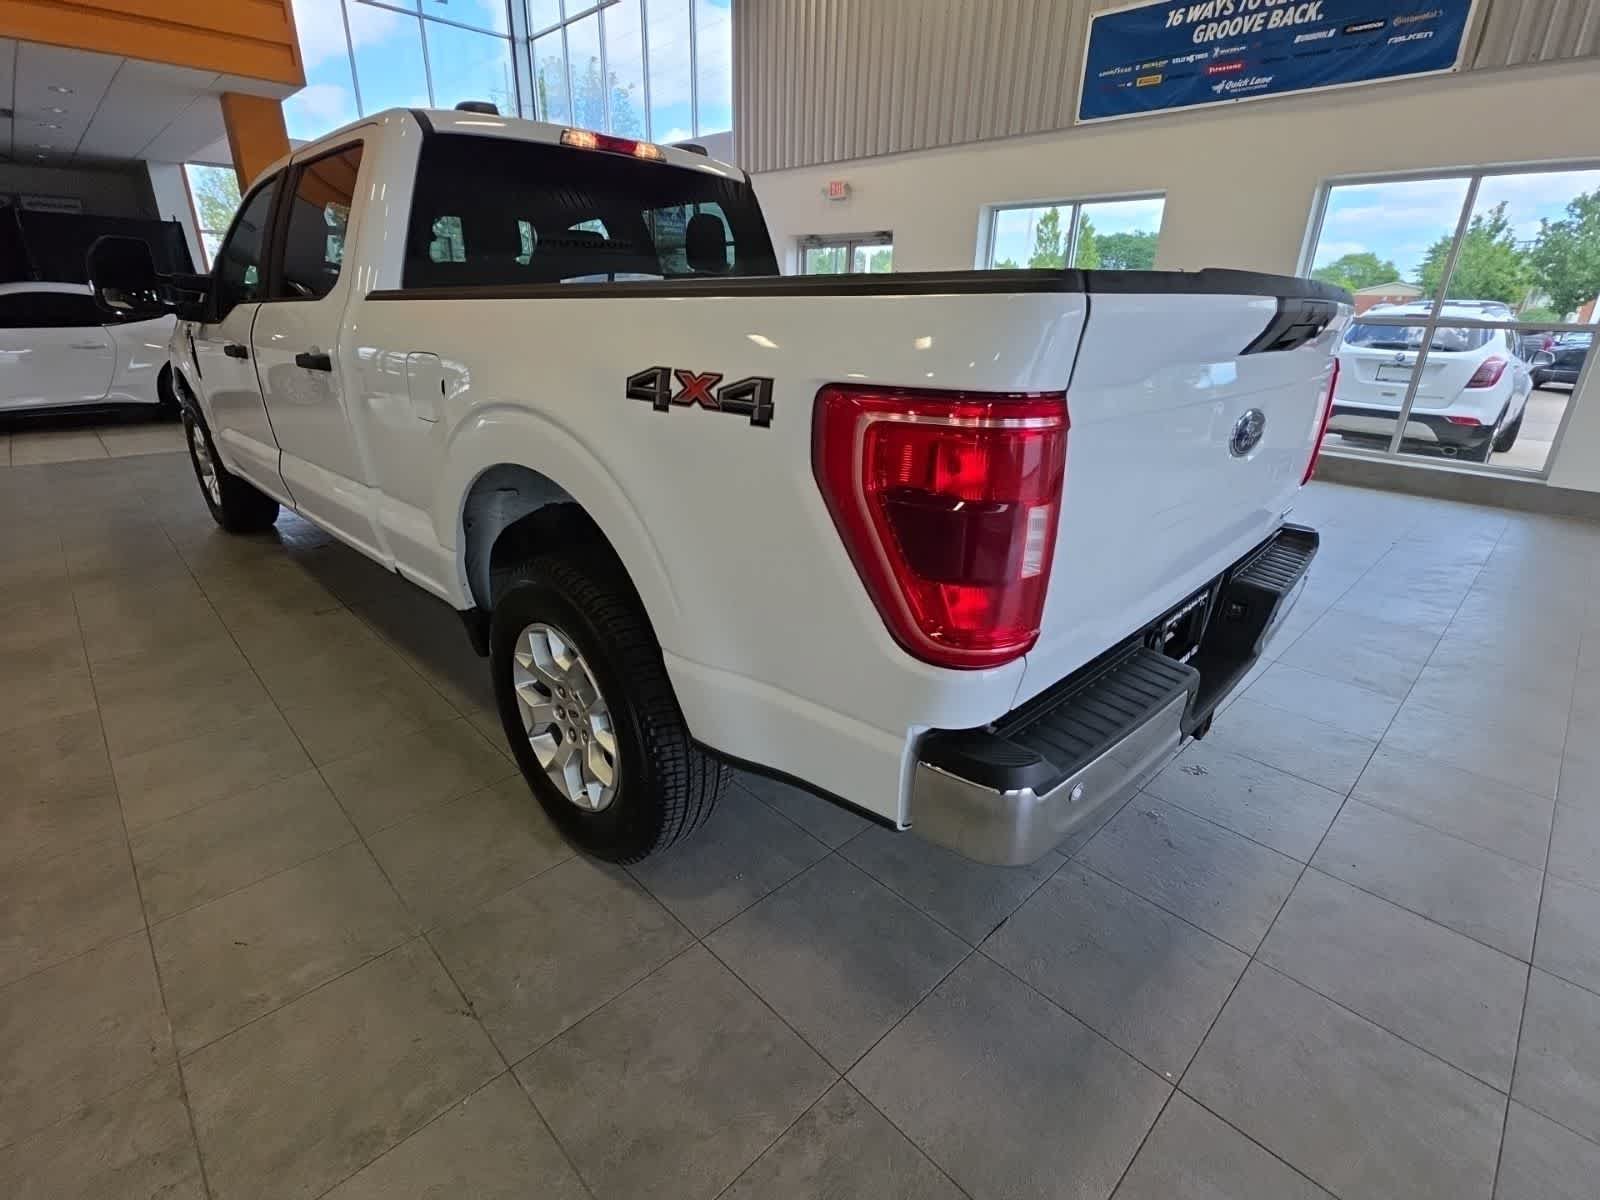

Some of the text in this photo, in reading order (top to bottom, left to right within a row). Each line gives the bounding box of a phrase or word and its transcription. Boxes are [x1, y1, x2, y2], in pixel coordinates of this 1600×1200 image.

[1165, 7, 1184, 28] 16
[1186, 0, 1235, 23] WAYS
[1193, 12, 1267, 43] GROOVE
[1267, 1, 1324, 30] BACK.
